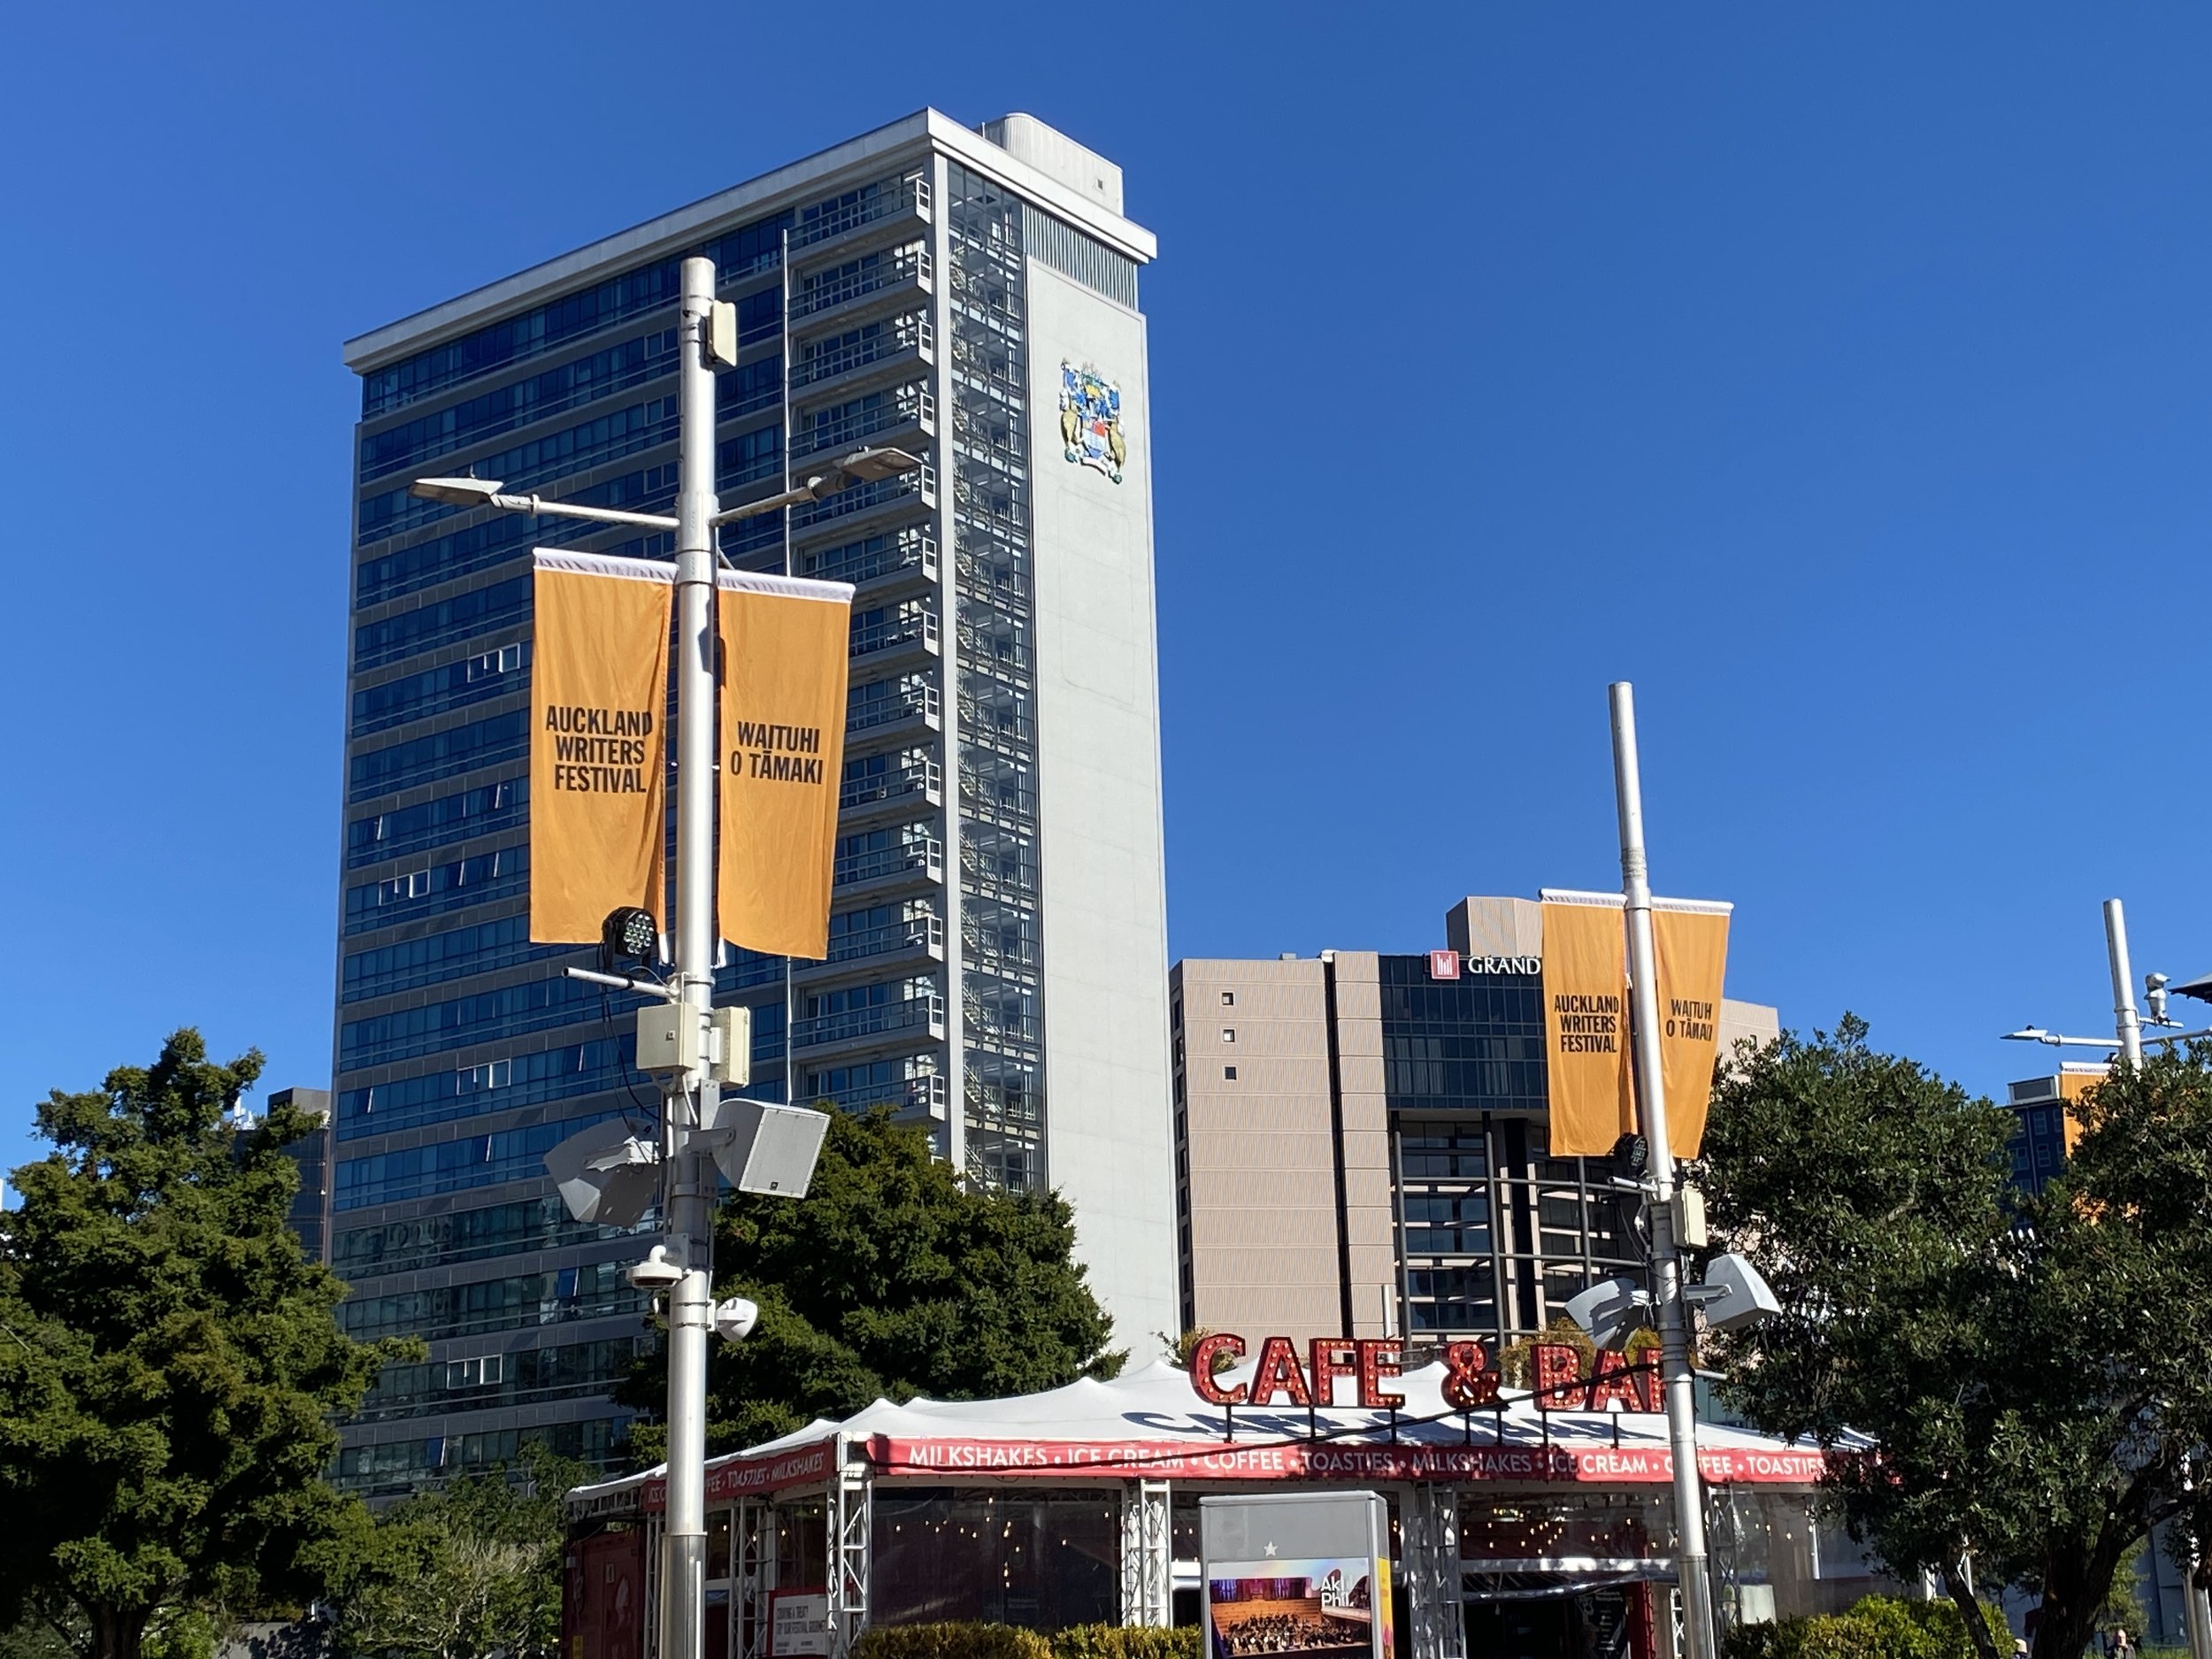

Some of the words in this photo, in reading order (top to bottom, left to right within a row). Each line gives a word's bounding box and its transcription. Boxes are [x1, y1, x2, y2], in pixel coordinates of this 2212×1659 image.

[546, 705, 653, 736] AUCKLAND
[555, 735, 645, 765] WRITERS
[737, 721, 821, 754] WAITUHI
[555, 764, 647, 794] FESTIVAL
[731, 750, 742, 776] O
[749, 750, 824, 785] TĀMAKI
[1468, 956, 1541, 975] GRAND
[1555, 995, 1619, 1015] AUCKLAND
[1671, 998, 1713, 1020] WAITUH
[1560, 1014, 1617, 1033] WRITERS
[1666, 1019, 1675, 1037] O
[1560, 1035, 1617, 1053] FESTIVAL
[1190, 1333, 1407, 1409] CAFE
[1440, 1340, 1502, 1409] &
[771, 1452, 825, 1482] MILKSHAKES
[908, 1445, 1048, 1466] MILKSHAKES
[1068, 1448, 1102, 1468] ICE
[1108, 1448, 1185, 1469] CREAM
[1203, 1451, 1283, 1471] COFFEE
[1301, 1452, 1394, 1471] TOASTIES
[1413, 1453, 1532, 1473] MILKSHAKES
[1550, 1455, 1578, 1473] ICE
[1582, 1455, 1648, 1474] CREAM
